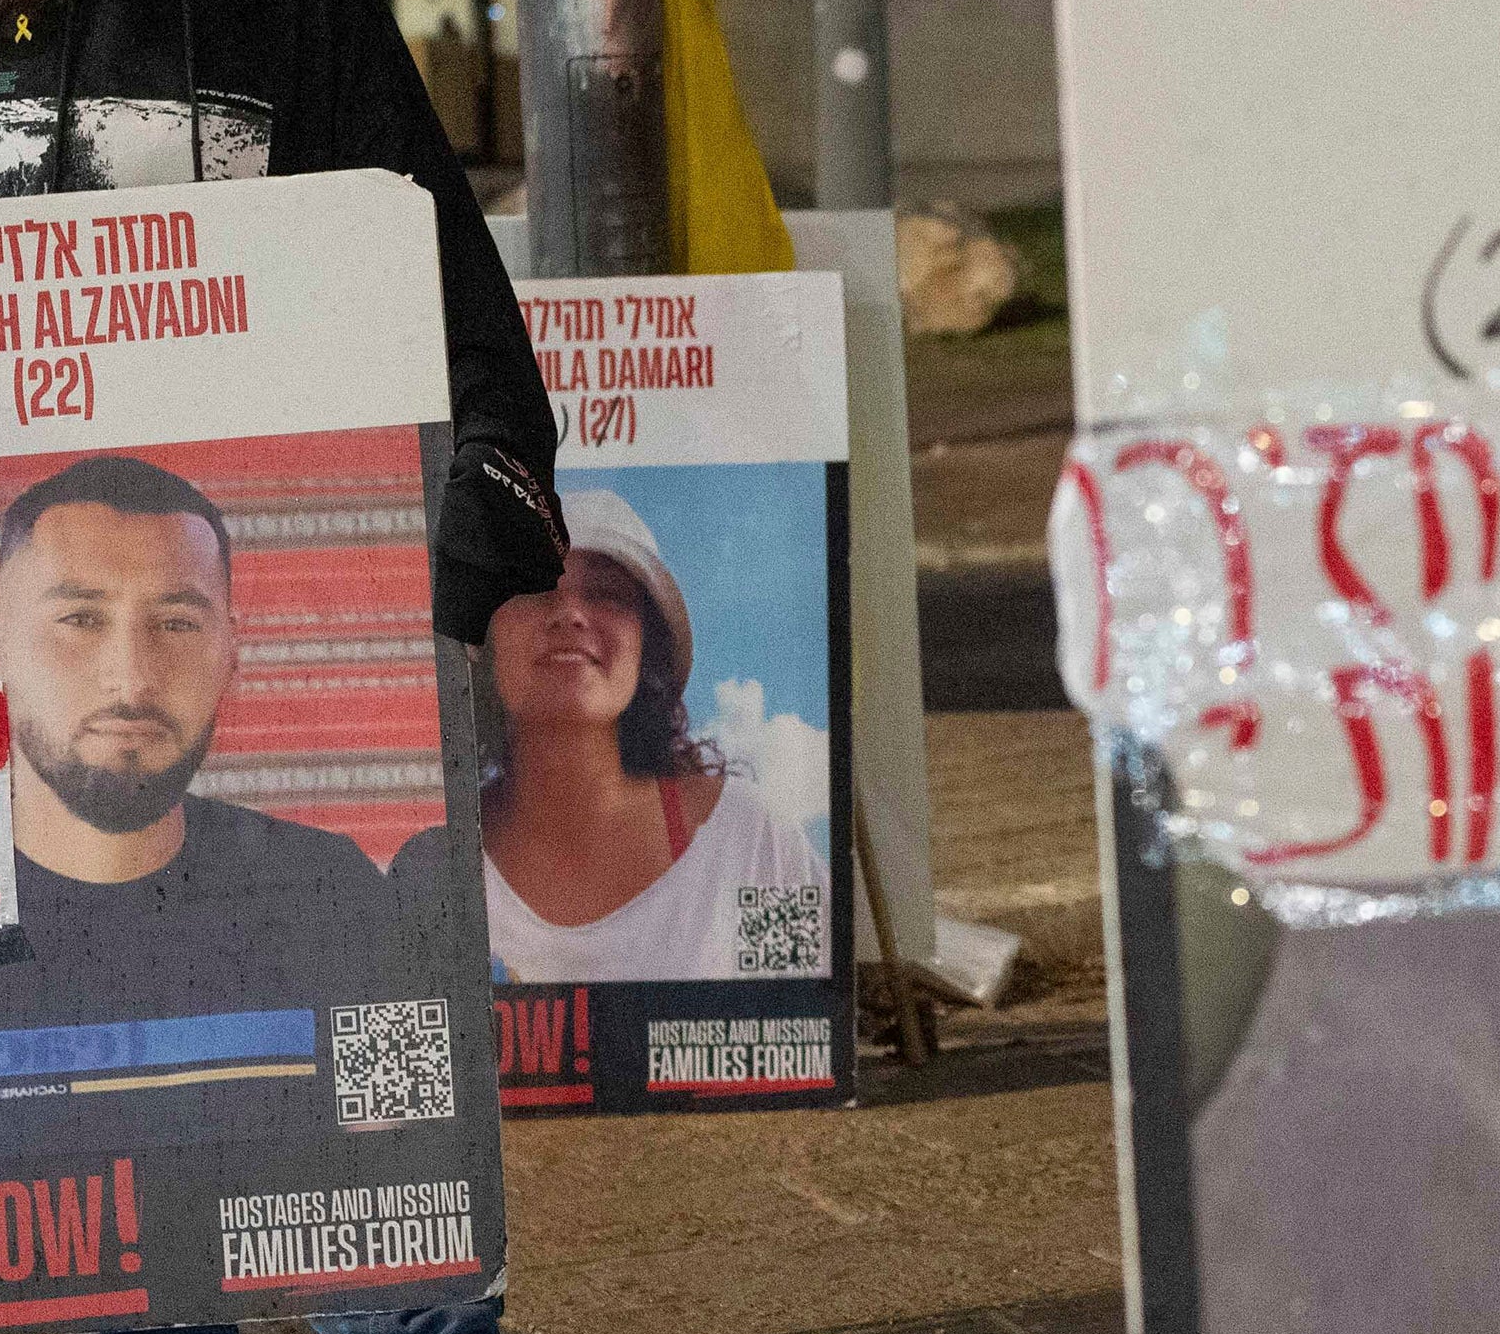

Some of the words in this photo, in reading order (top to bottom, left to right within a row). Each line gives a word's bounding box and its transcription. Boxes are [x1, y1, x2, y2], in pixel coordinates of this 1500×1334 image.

[92, 211, 197, 275] חמזה
[34, 275, 248, 348] ALZAYADNI
[614, 294, 697, 340] אמילי
[14, 352, 94, 425] (22)
[600, 344, 713, 390] DAMARI
[648, 1020, 726, 1045] HOSTAGES
[729, 1019, 760, 1044] AND
[762, 1018, 831, 1043] MISSING
[649, 1045, 748, 1082] FAMILIES
[752, 1044, 832, 1081] FORUM
[219, 1191, 325, 1230] HOSTAGES
[331, 1188, 373, 1222] AND
[377, 1180, 470, 1218] MISSING
[222, 1224, 358, 1279] FAMILIES
[366, 1216, 475, 1269] FORUM
